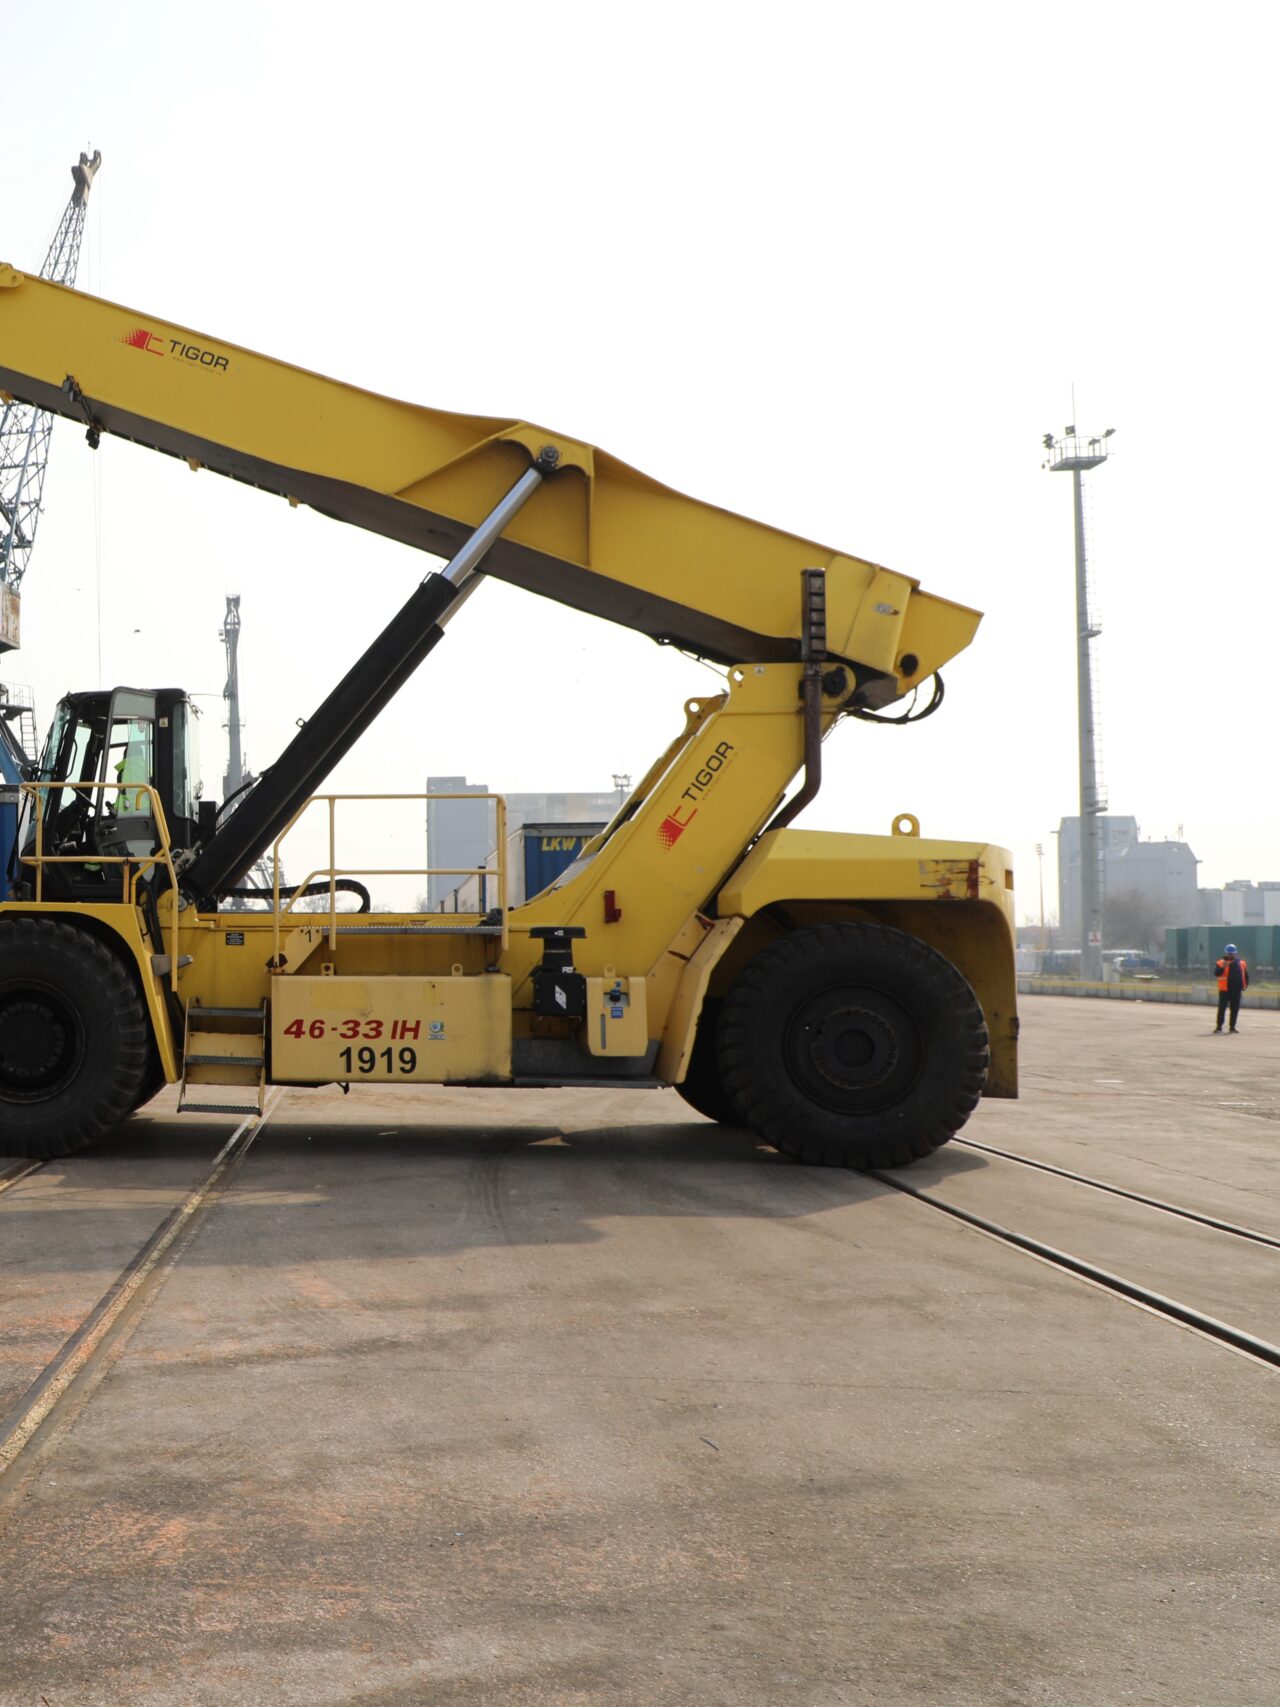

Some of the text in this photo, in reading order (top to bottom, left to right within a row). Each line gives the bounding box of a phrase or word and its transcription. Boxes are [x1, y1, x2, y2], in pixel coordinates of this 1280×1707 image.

[169, 339, 230, 371] TIGOR
[681, 741, 734, 801] TIGOR
[541, 836, 577, 851] LKW
[283, 1018, 421, 1040] 46-33 IH
[339, 1046, 417, 1074] 1919
